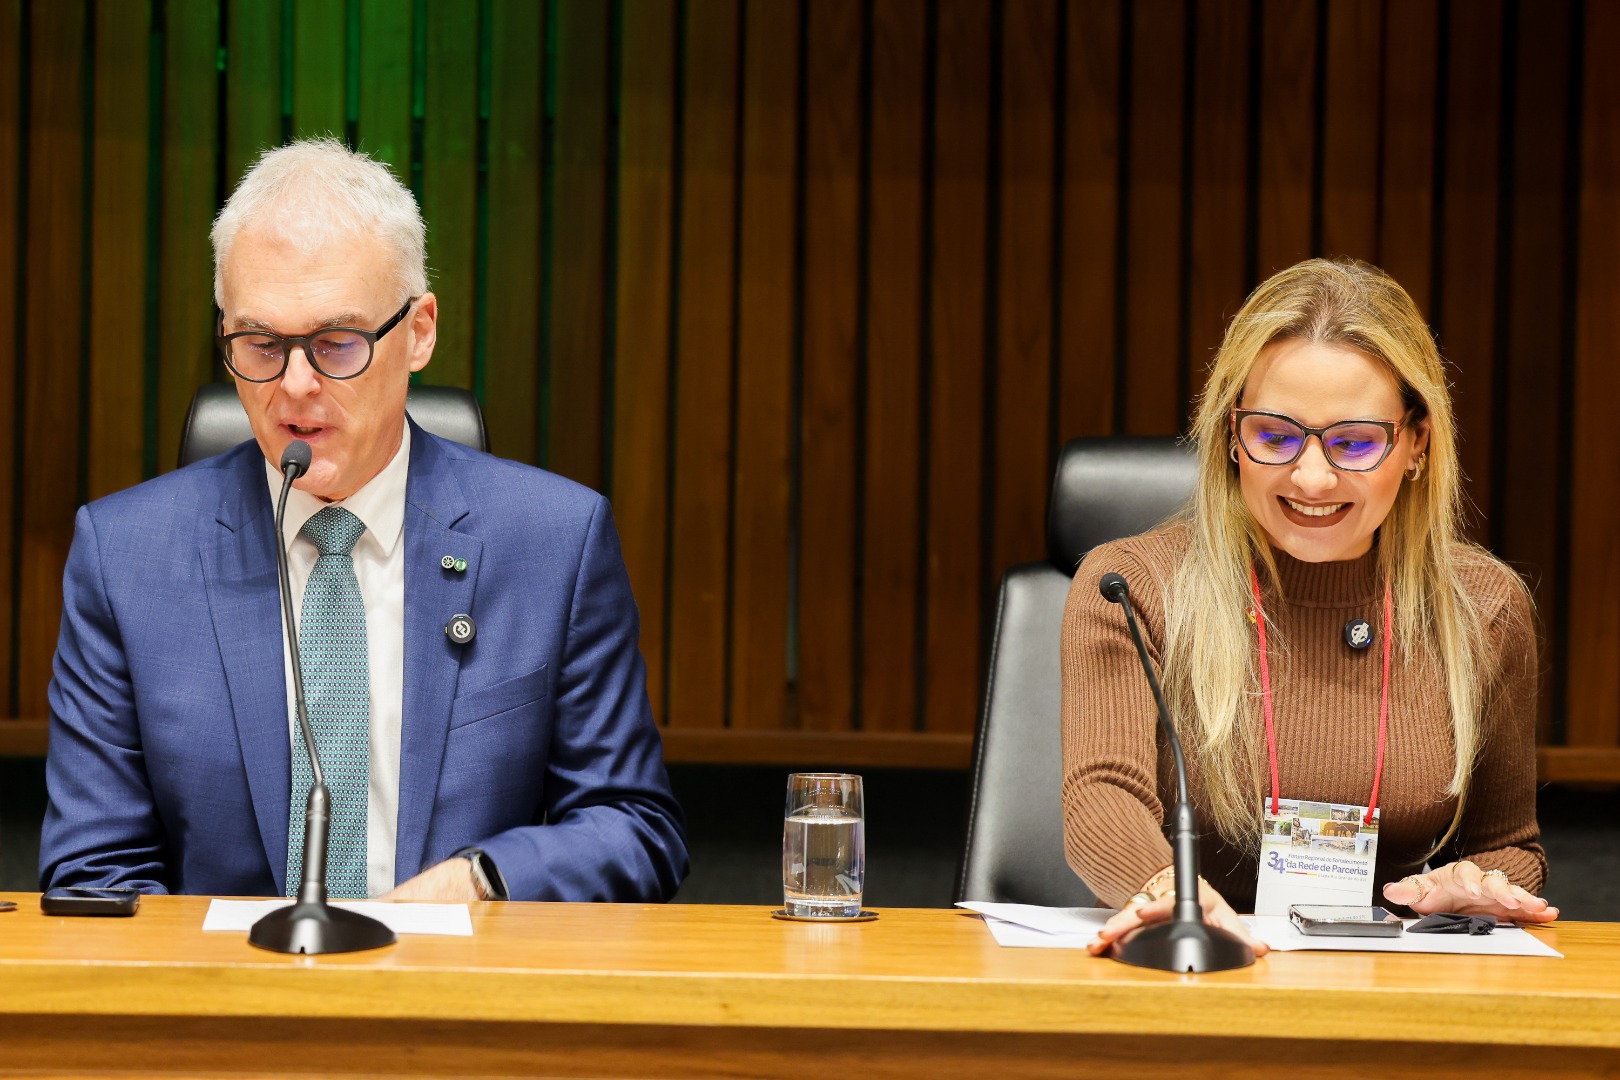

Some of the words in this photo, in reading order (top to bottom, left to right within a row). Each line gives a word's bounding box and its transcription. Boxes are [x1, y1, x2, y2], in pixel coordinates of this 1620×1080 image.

[1305, 854, 1325, 862] Regional
[1333, 857, 1367, 866] Fortalecimento
[1286, 860, 1297, 869] da
[1298, 861, 1319, 871] Rede
[1320, 863, 1330, 872] de
[1332, 864, 1368, 876] Parcerias
